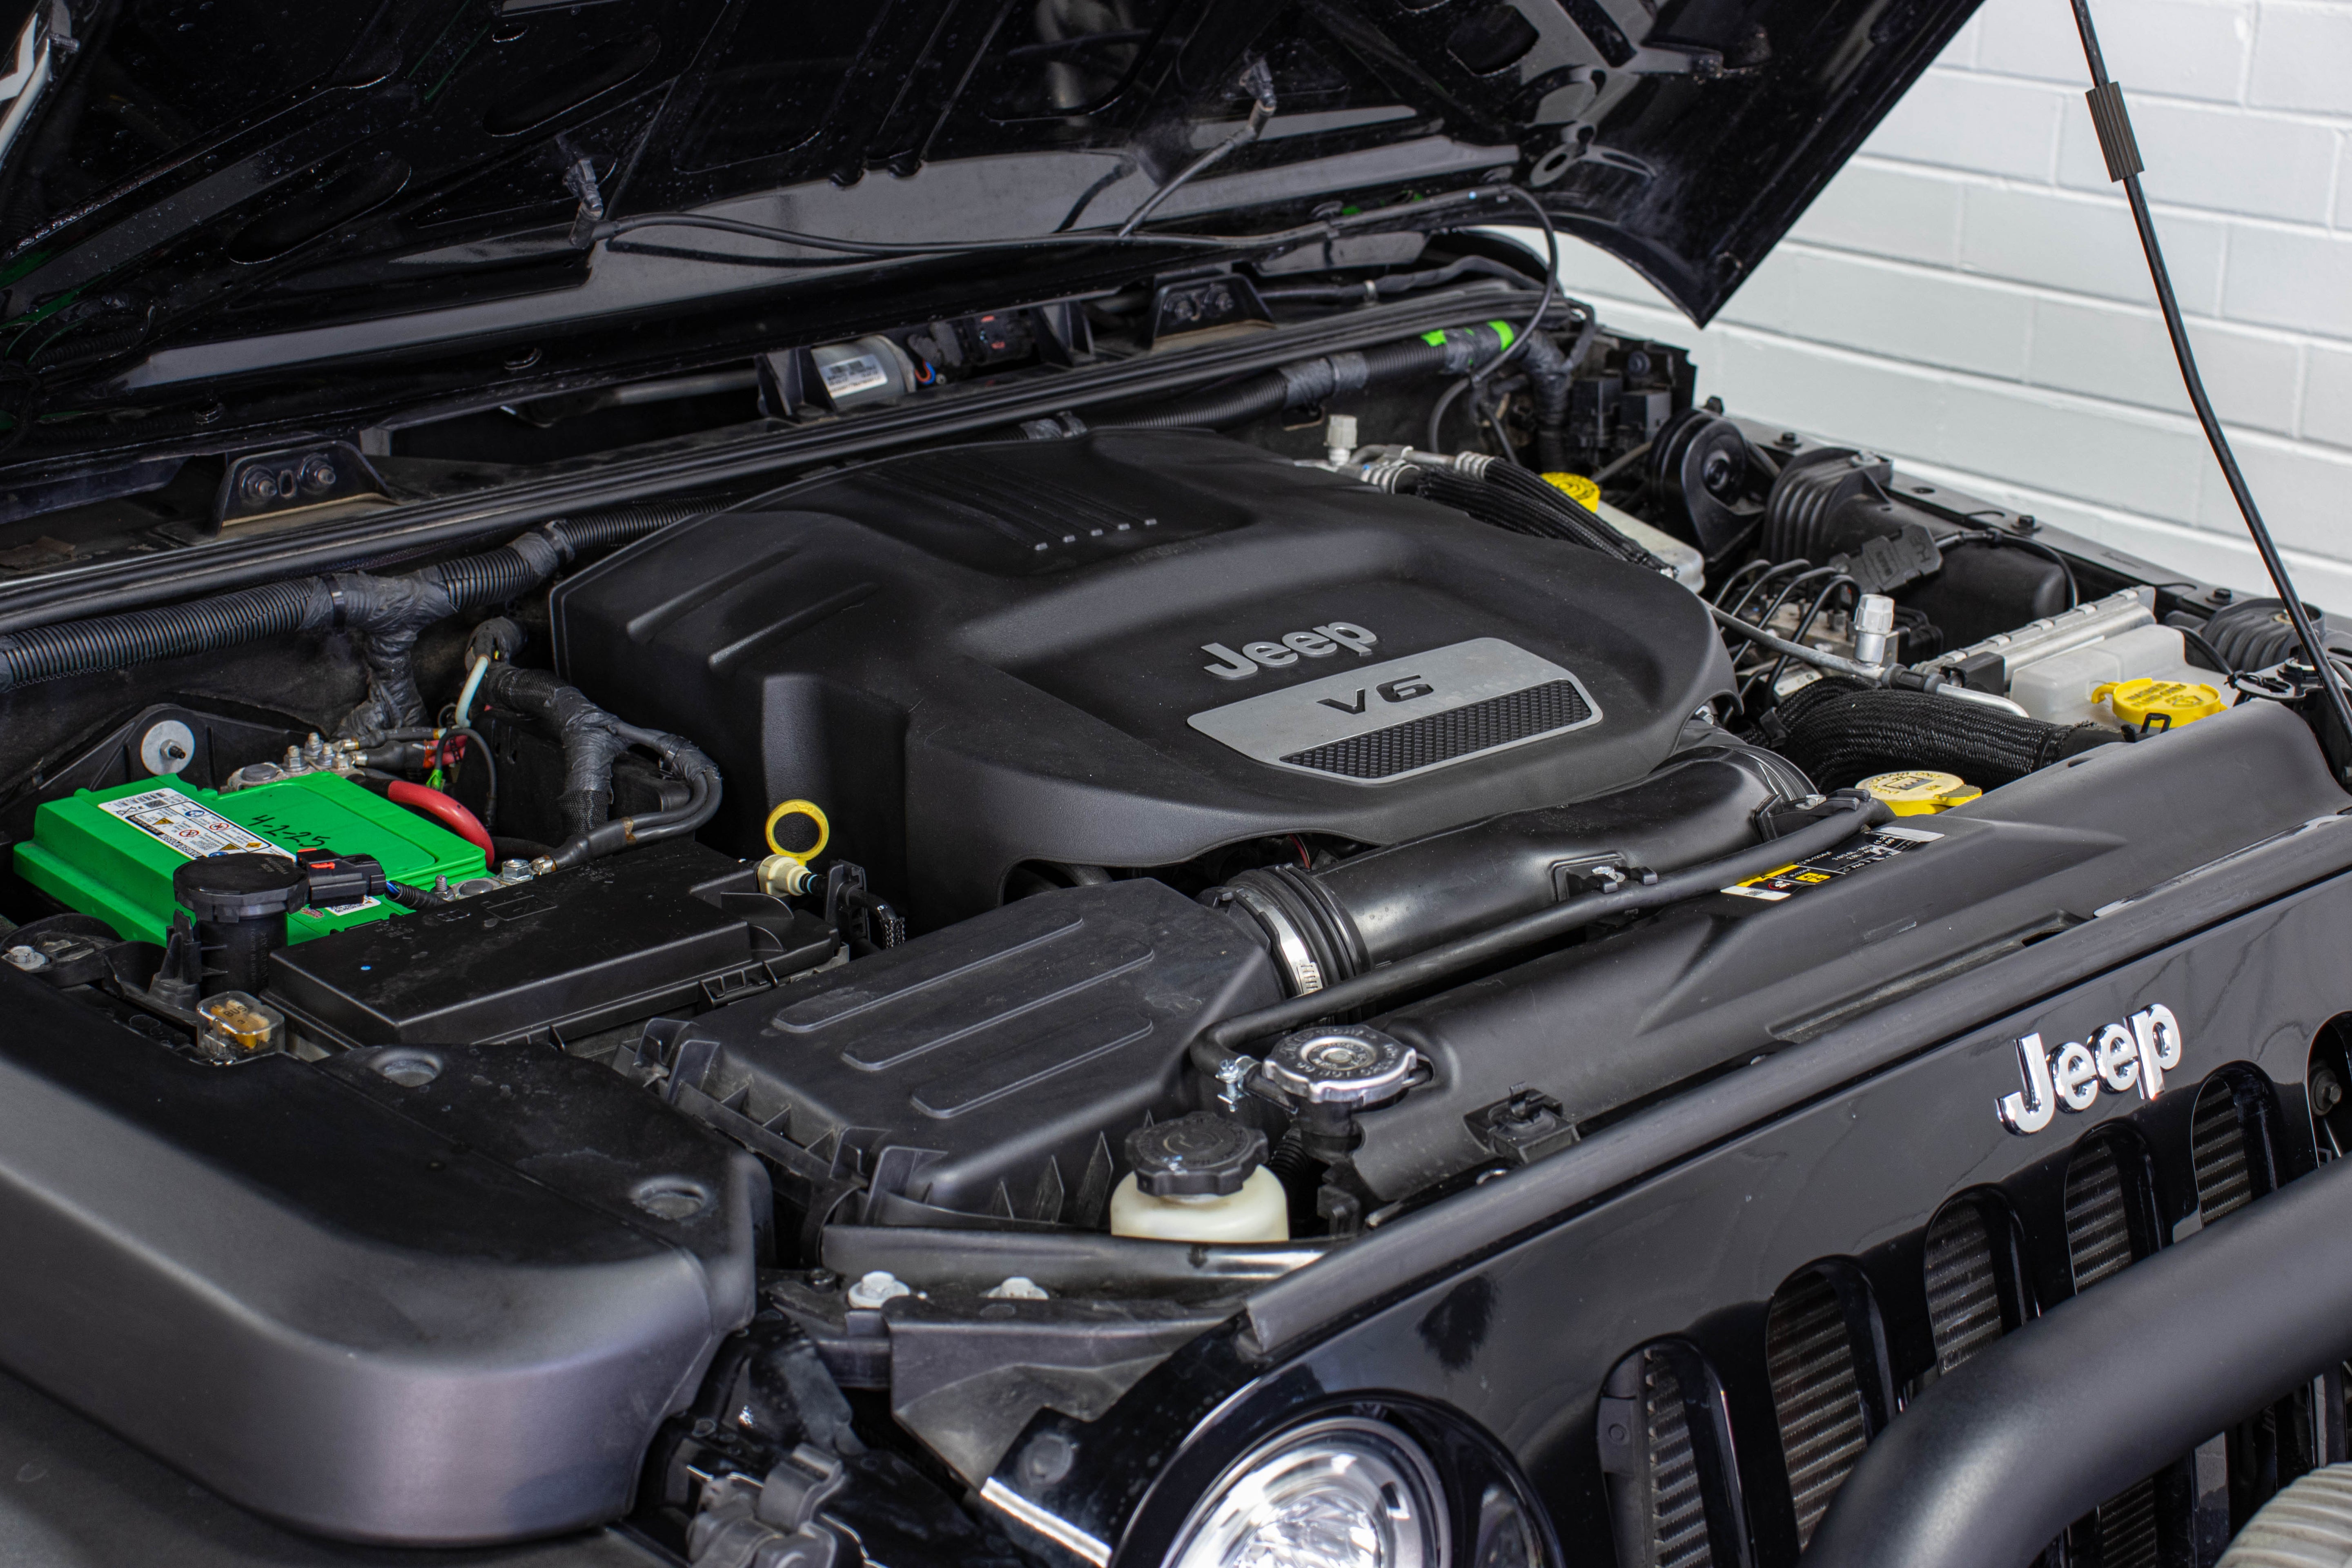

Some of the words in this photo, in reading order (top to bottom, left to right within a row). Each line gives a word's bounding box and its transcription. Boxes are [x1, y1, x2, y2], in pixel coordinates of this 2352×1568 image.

[1201, 622, 1378, 681] Jeep
[1316, 674, 1434, 715] V6
[247, 814, 331, 847] 4-2-25
[1995, 1003, 2181, 1136] Jeep
